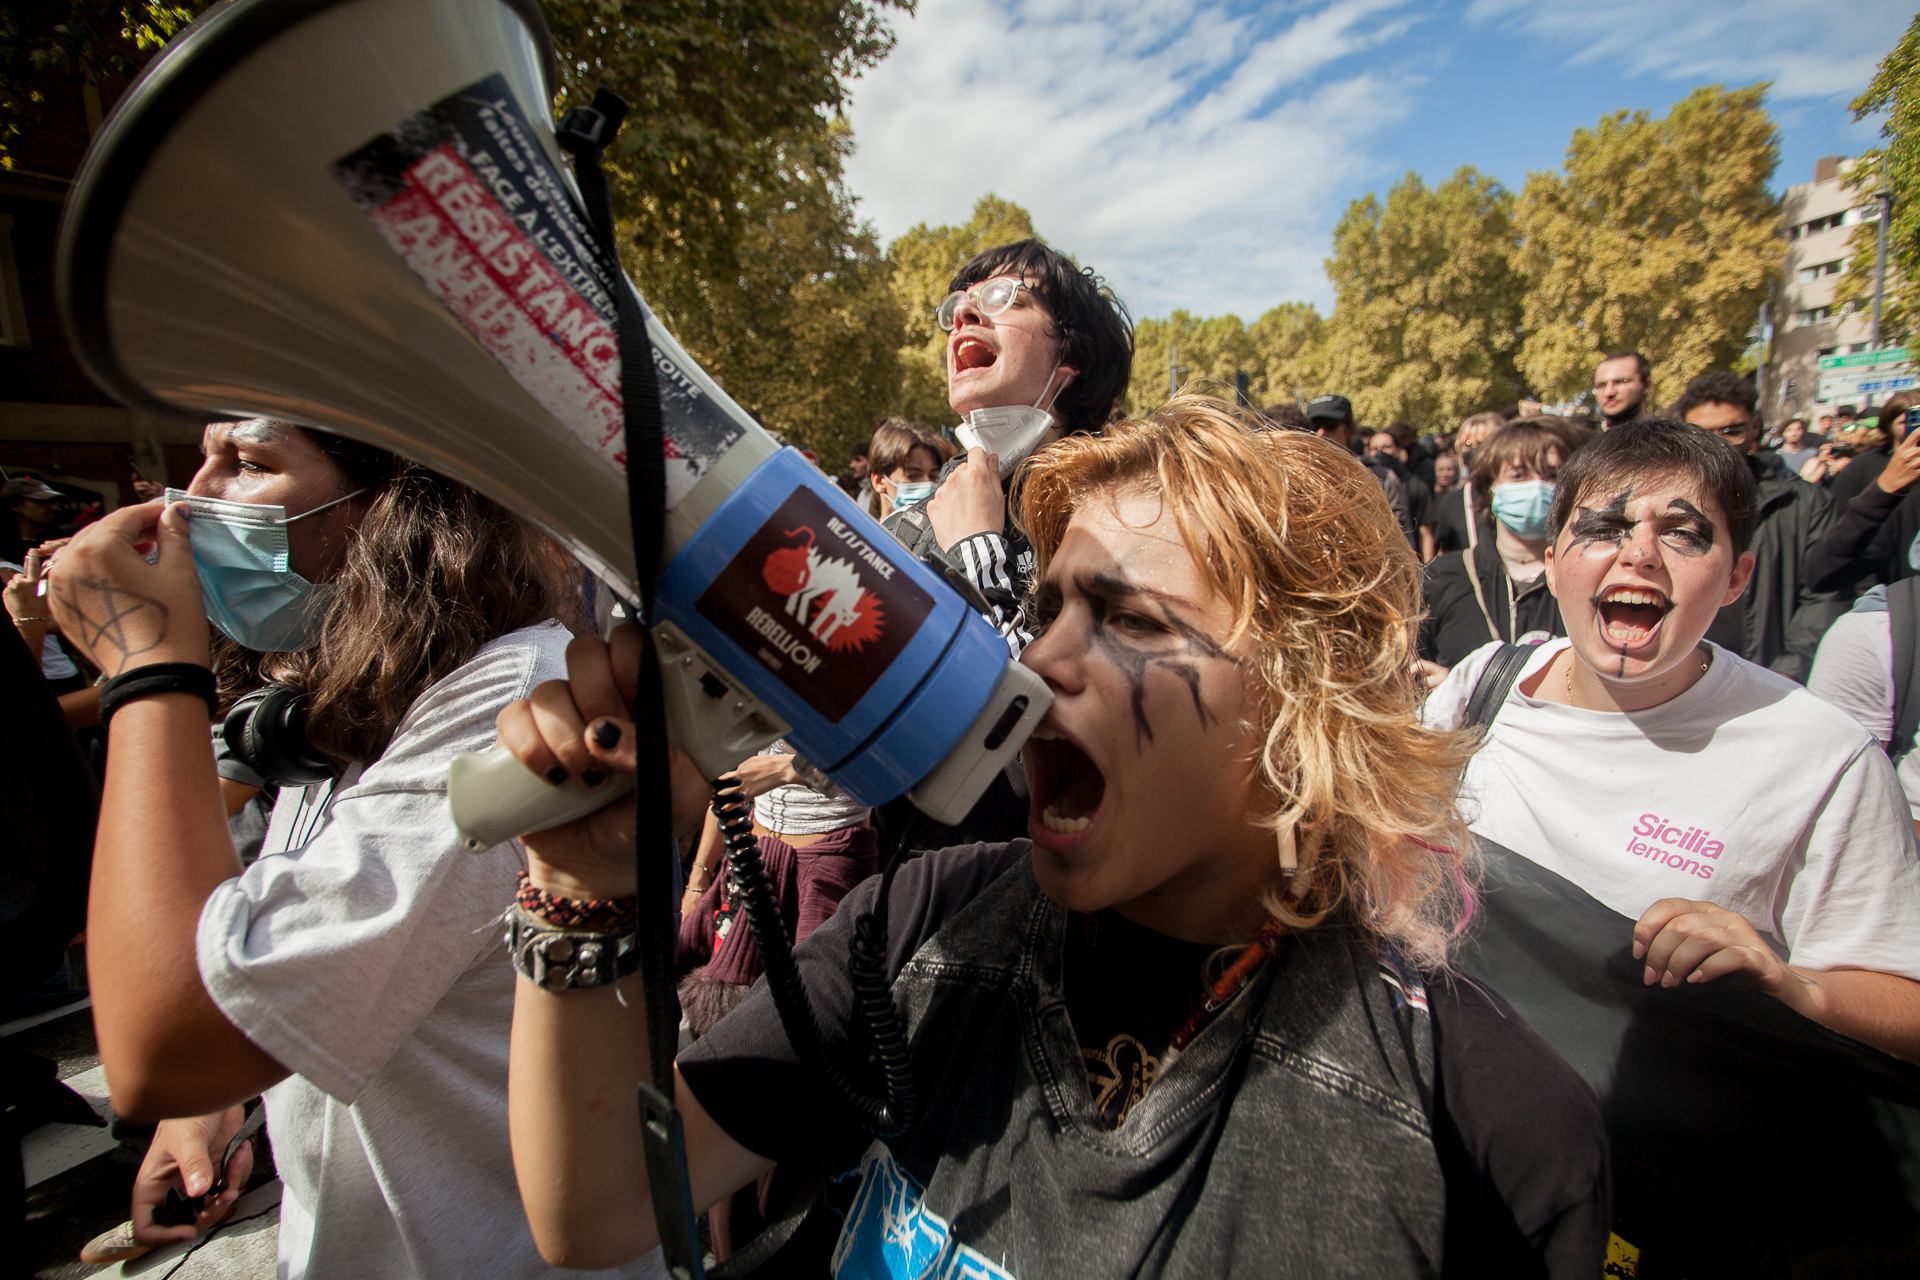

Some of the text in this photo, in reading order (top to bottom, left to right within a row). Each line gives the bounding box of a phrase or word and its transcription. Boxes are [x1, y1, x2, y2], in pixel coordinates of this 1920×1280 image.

[478, 108, 526, 173] faites
[524, 175, 547, 202] de
[470, 151, 525, 211] FACE
[651, 346, 702, 400] ROITE
[745, 606, 822, 675] RÉBELLION
[1625, 836, 1715, 880] lemons
[1632, 813, 1725, 860] Sicilia
